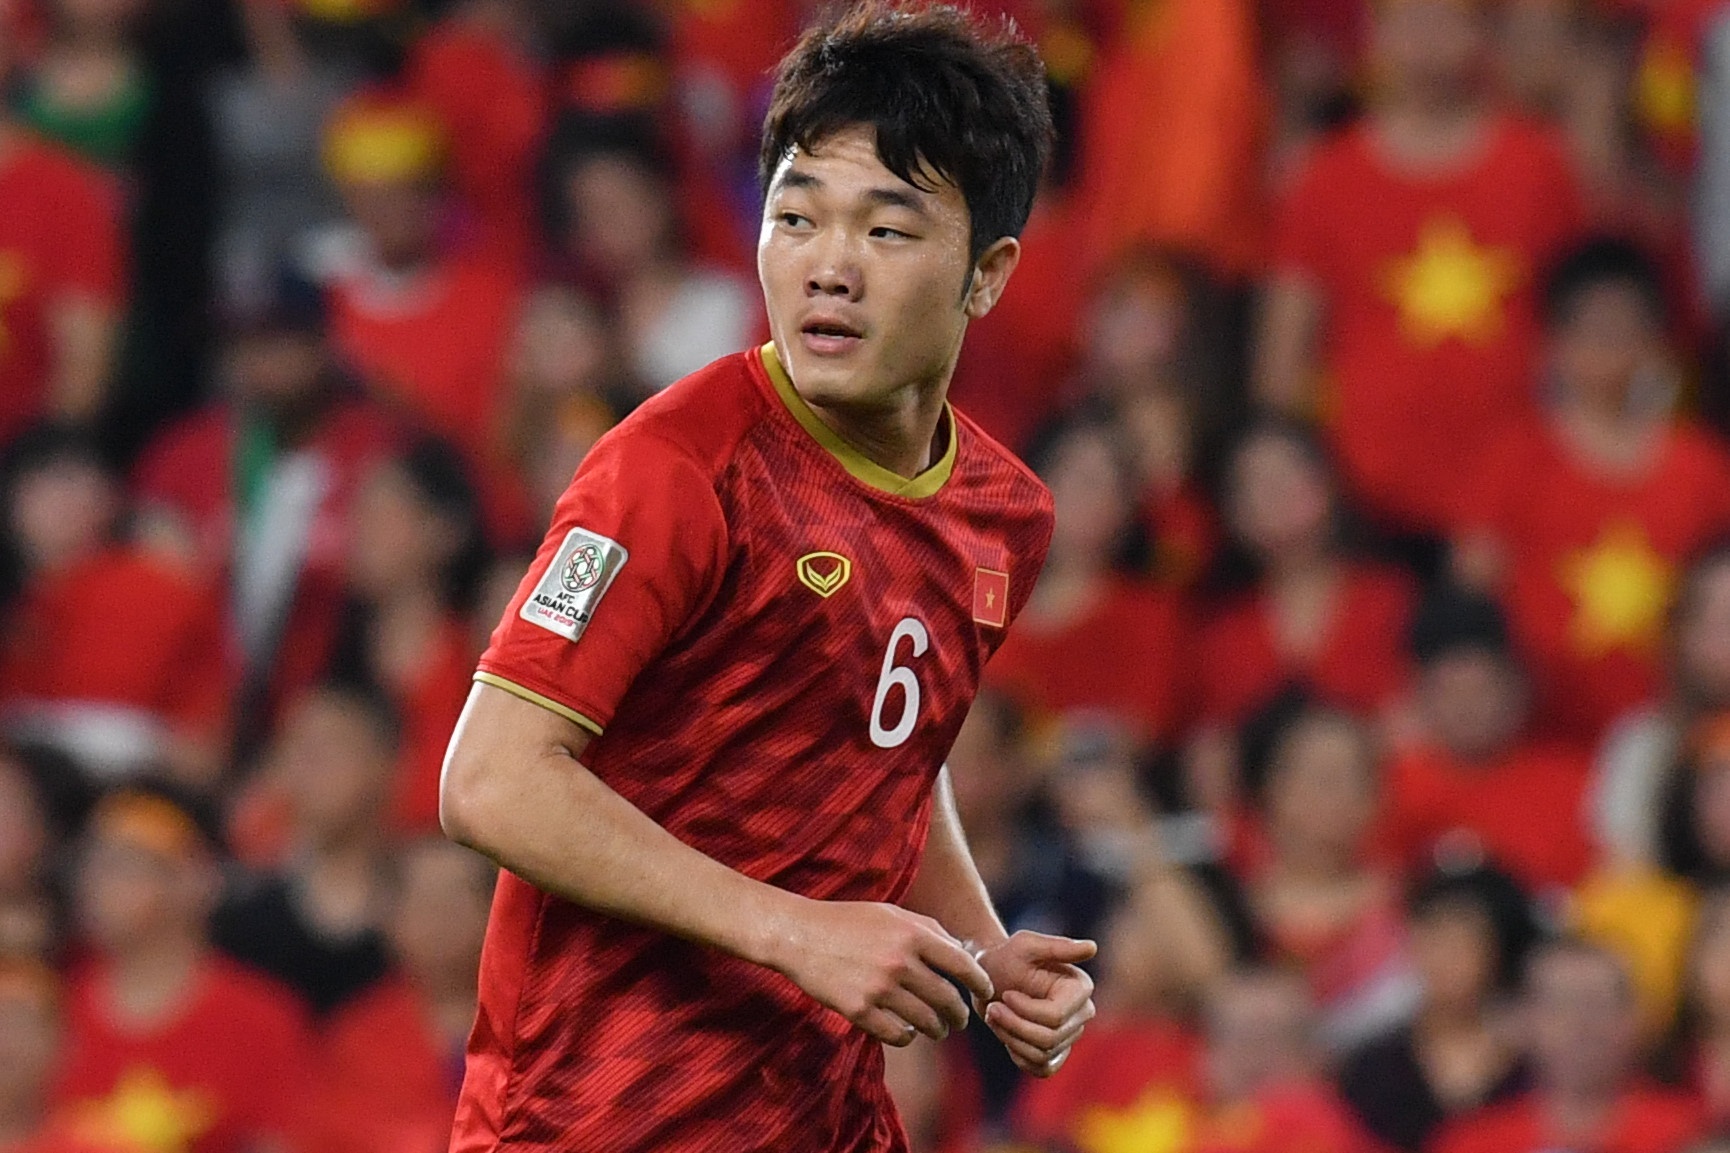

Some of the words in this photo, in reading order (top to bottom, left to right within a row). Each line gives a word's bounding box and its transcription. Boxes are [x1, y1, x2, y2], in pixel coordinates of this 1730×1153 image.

[557, 592, 575, 604] AFC
[533, 594, 565, 613] ASIAN
[565, 606, 588, 623] CUP
[538, 607, 553, 618] UAE
[869, 617, 928, 748] 6
